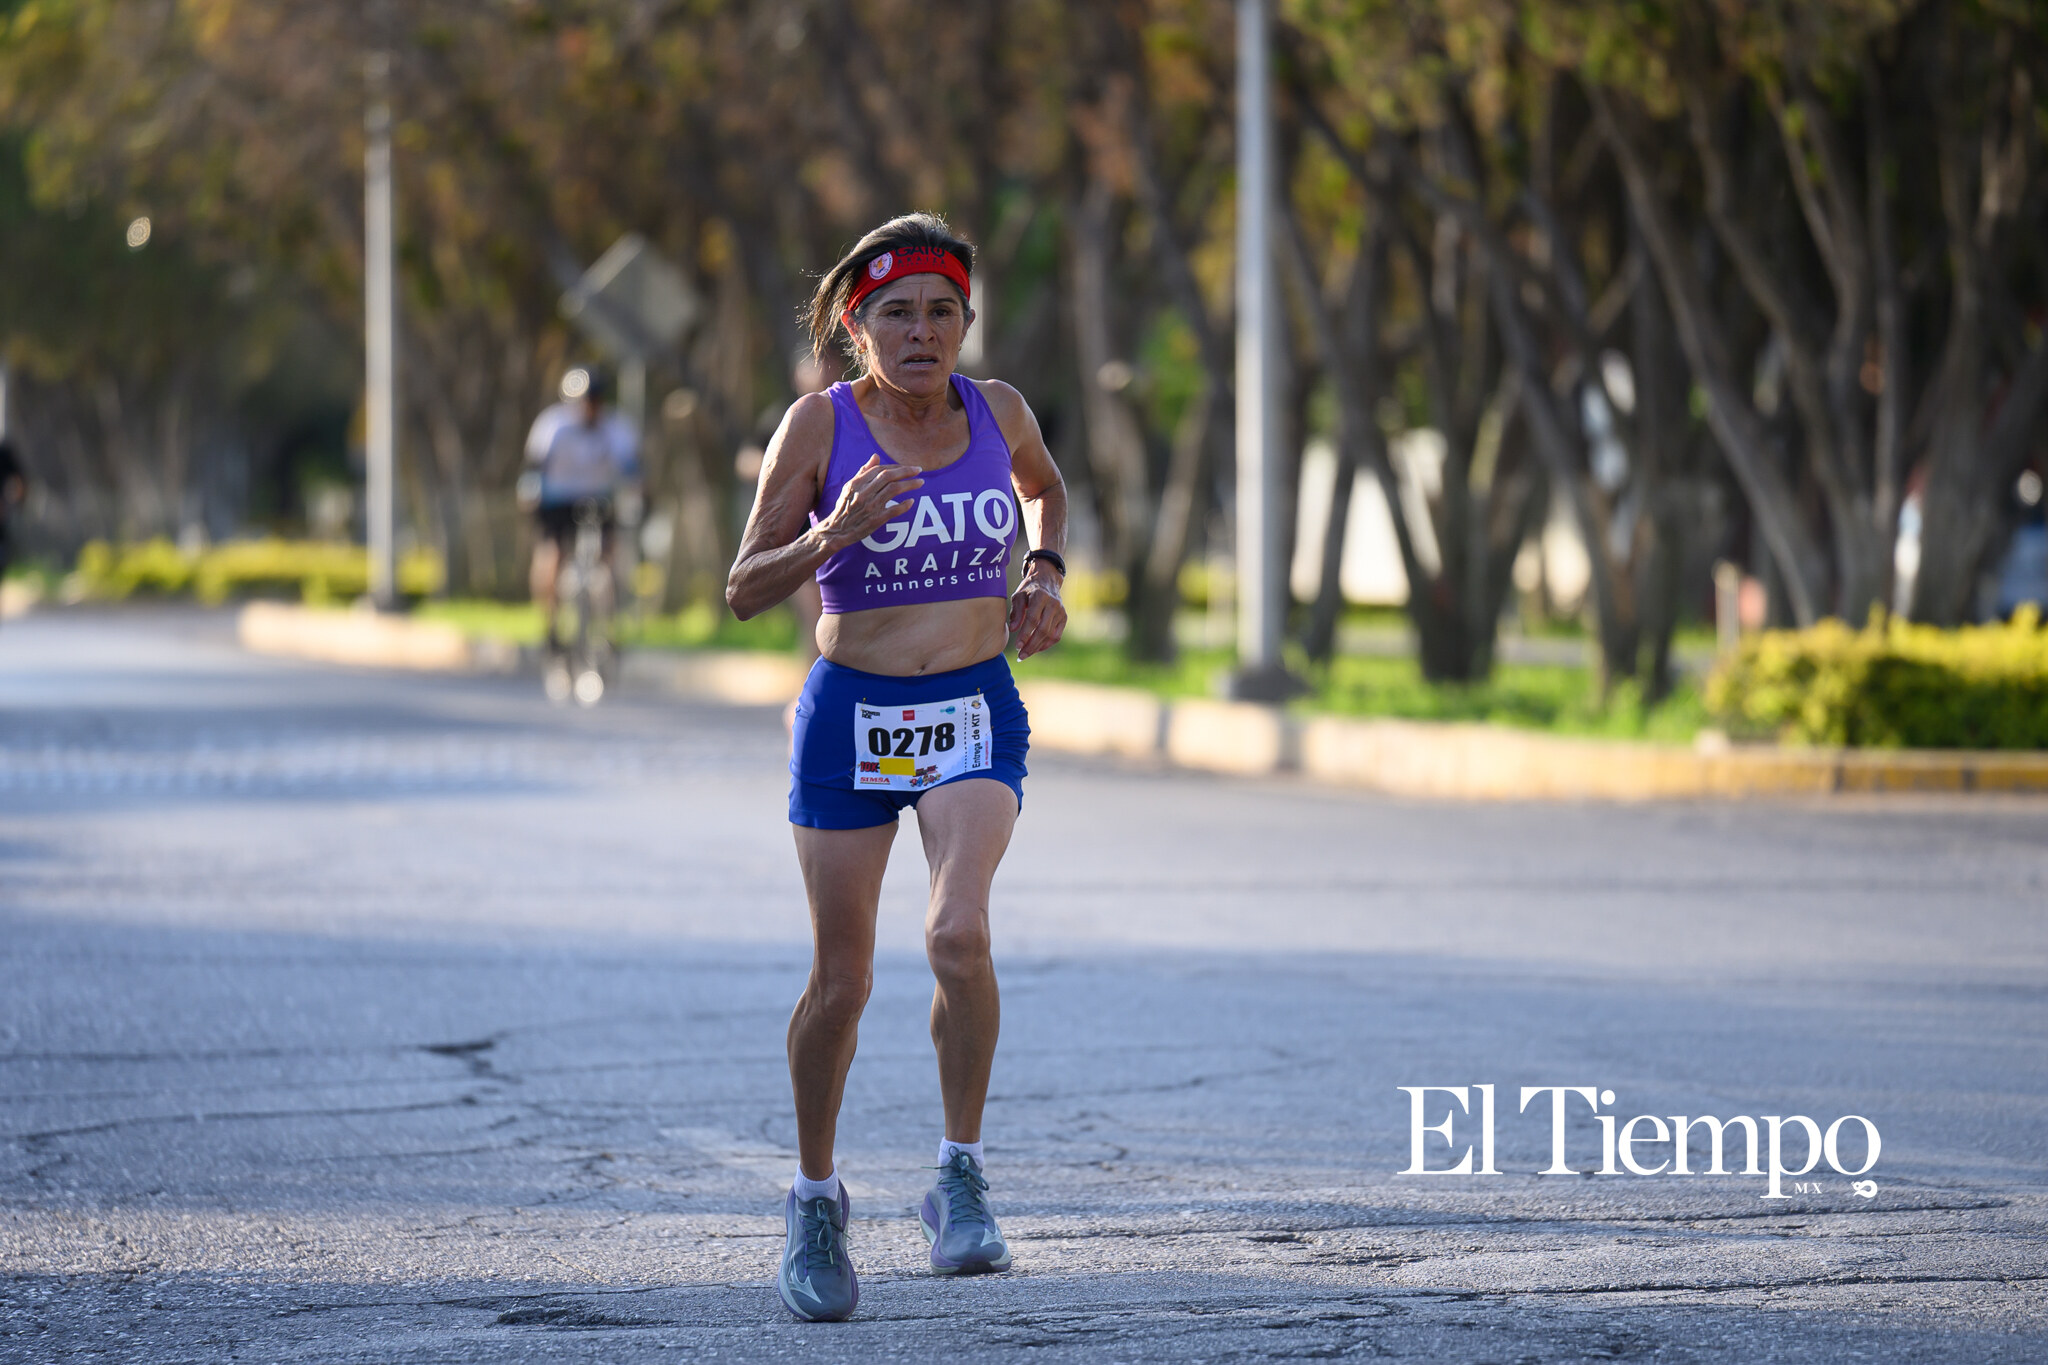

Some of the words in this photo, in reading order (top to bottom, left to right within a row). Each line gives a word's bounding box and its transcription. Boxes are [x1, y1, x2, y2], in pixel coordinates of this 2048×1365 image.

[865, 547, 1007, 578] ARAIZA
[865, 575, 958, 594] runners
[967, 565, 1001, 582] club
[972, 713, 980, 727] KIT
[868, 722, 955, 757] 0278
[972, 729, 980, 740] de
[972, 742, 983, 768] Entrega
